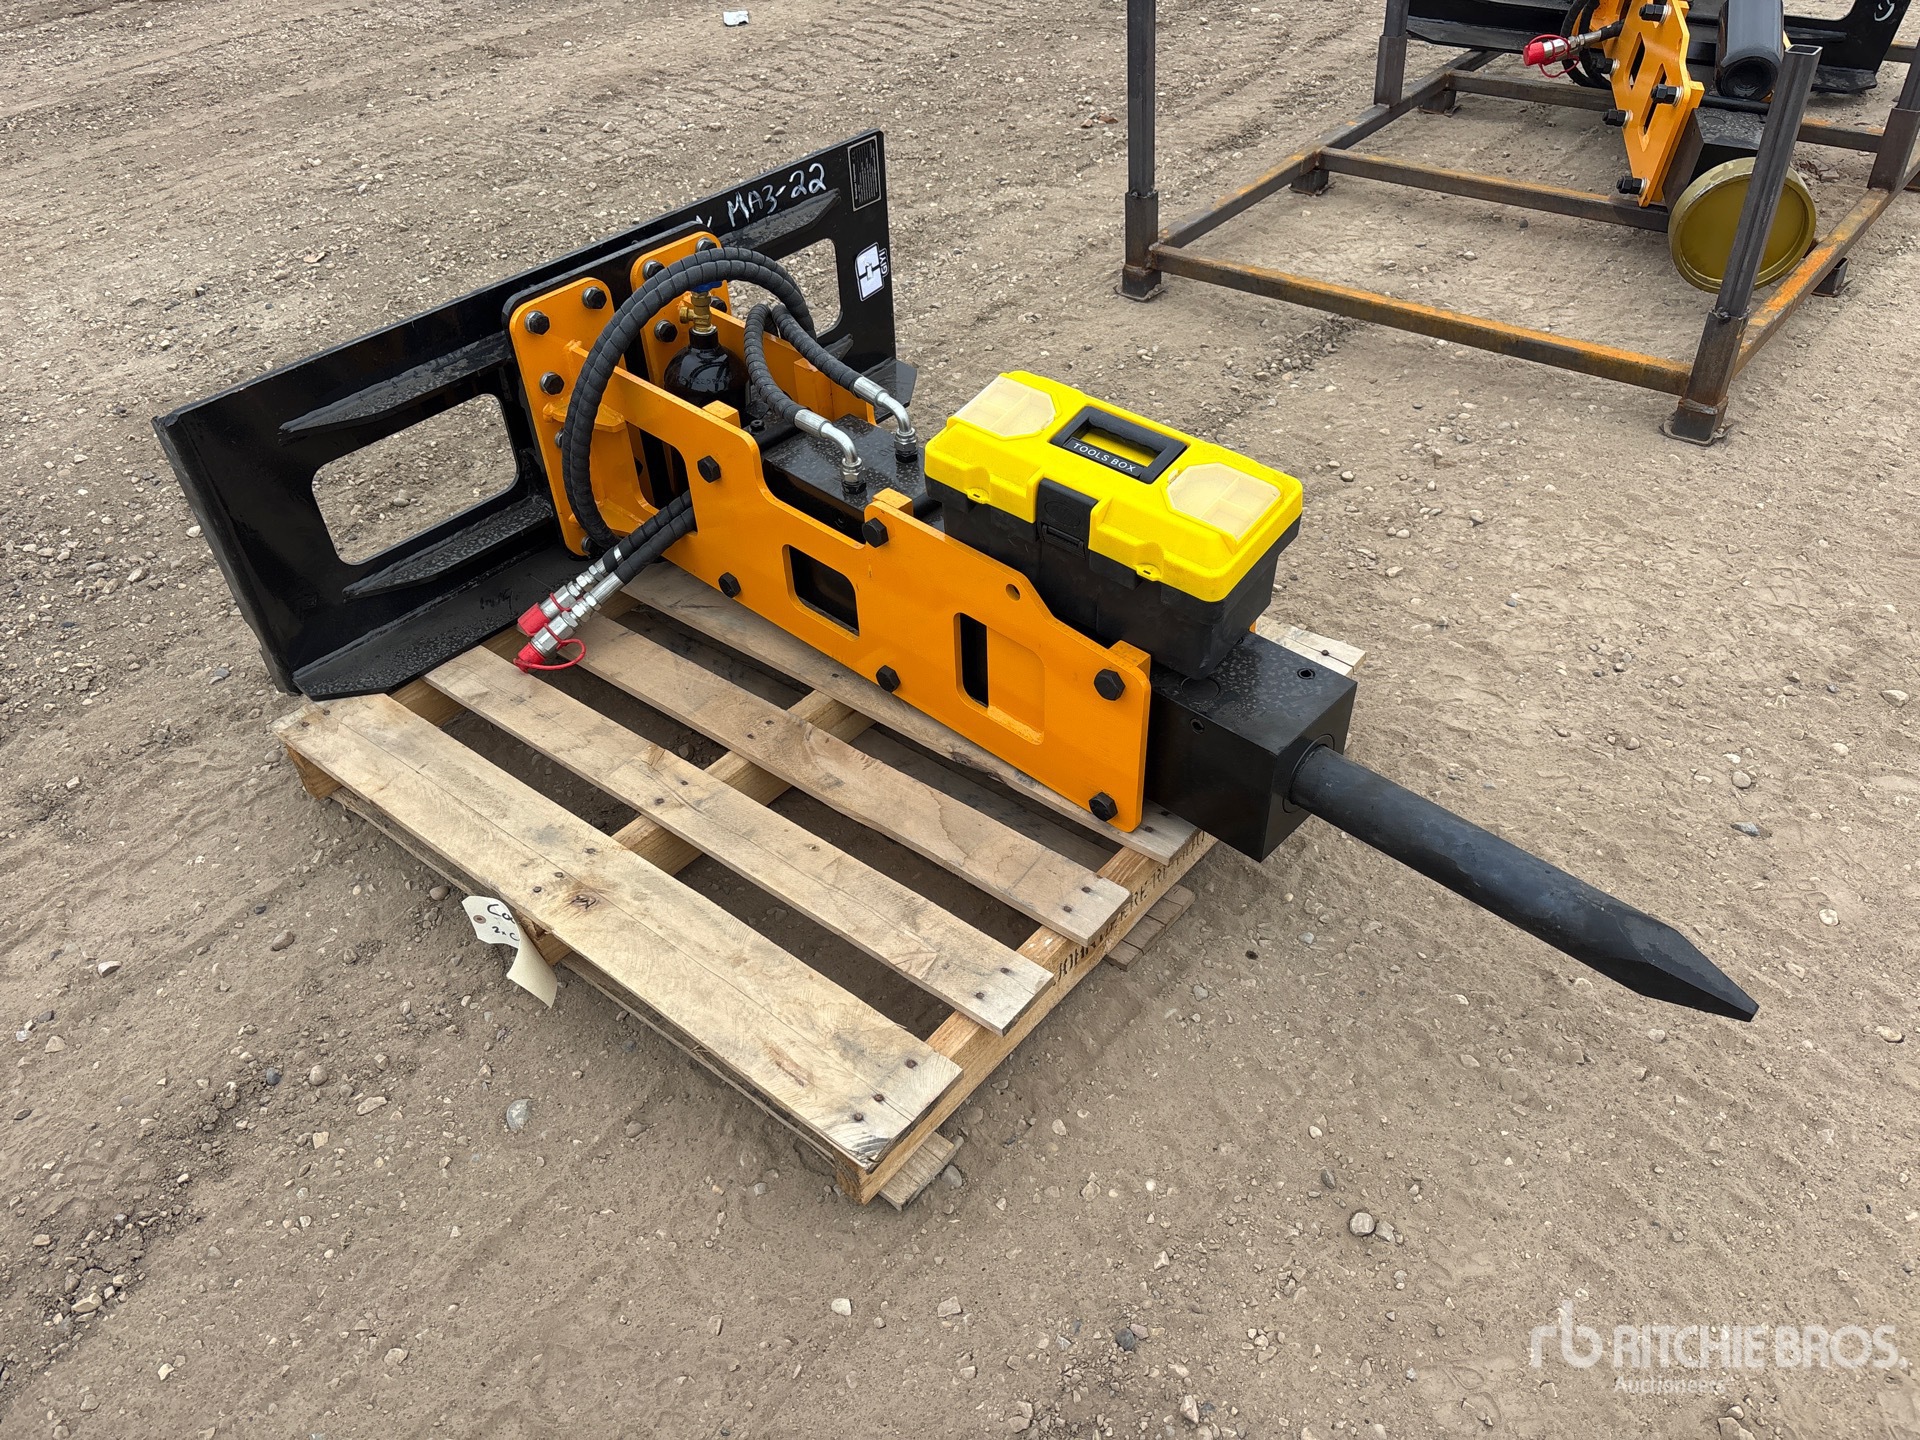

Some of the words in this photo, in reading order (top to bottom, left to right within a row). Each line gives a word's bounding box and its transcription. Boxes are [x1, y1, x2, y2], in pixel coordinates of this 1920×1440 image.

[879, 251, 888, 275] GIYI
[1073, 442, 1110, 462] TOOLS
[1110, 458, 1136, 473] BOX
